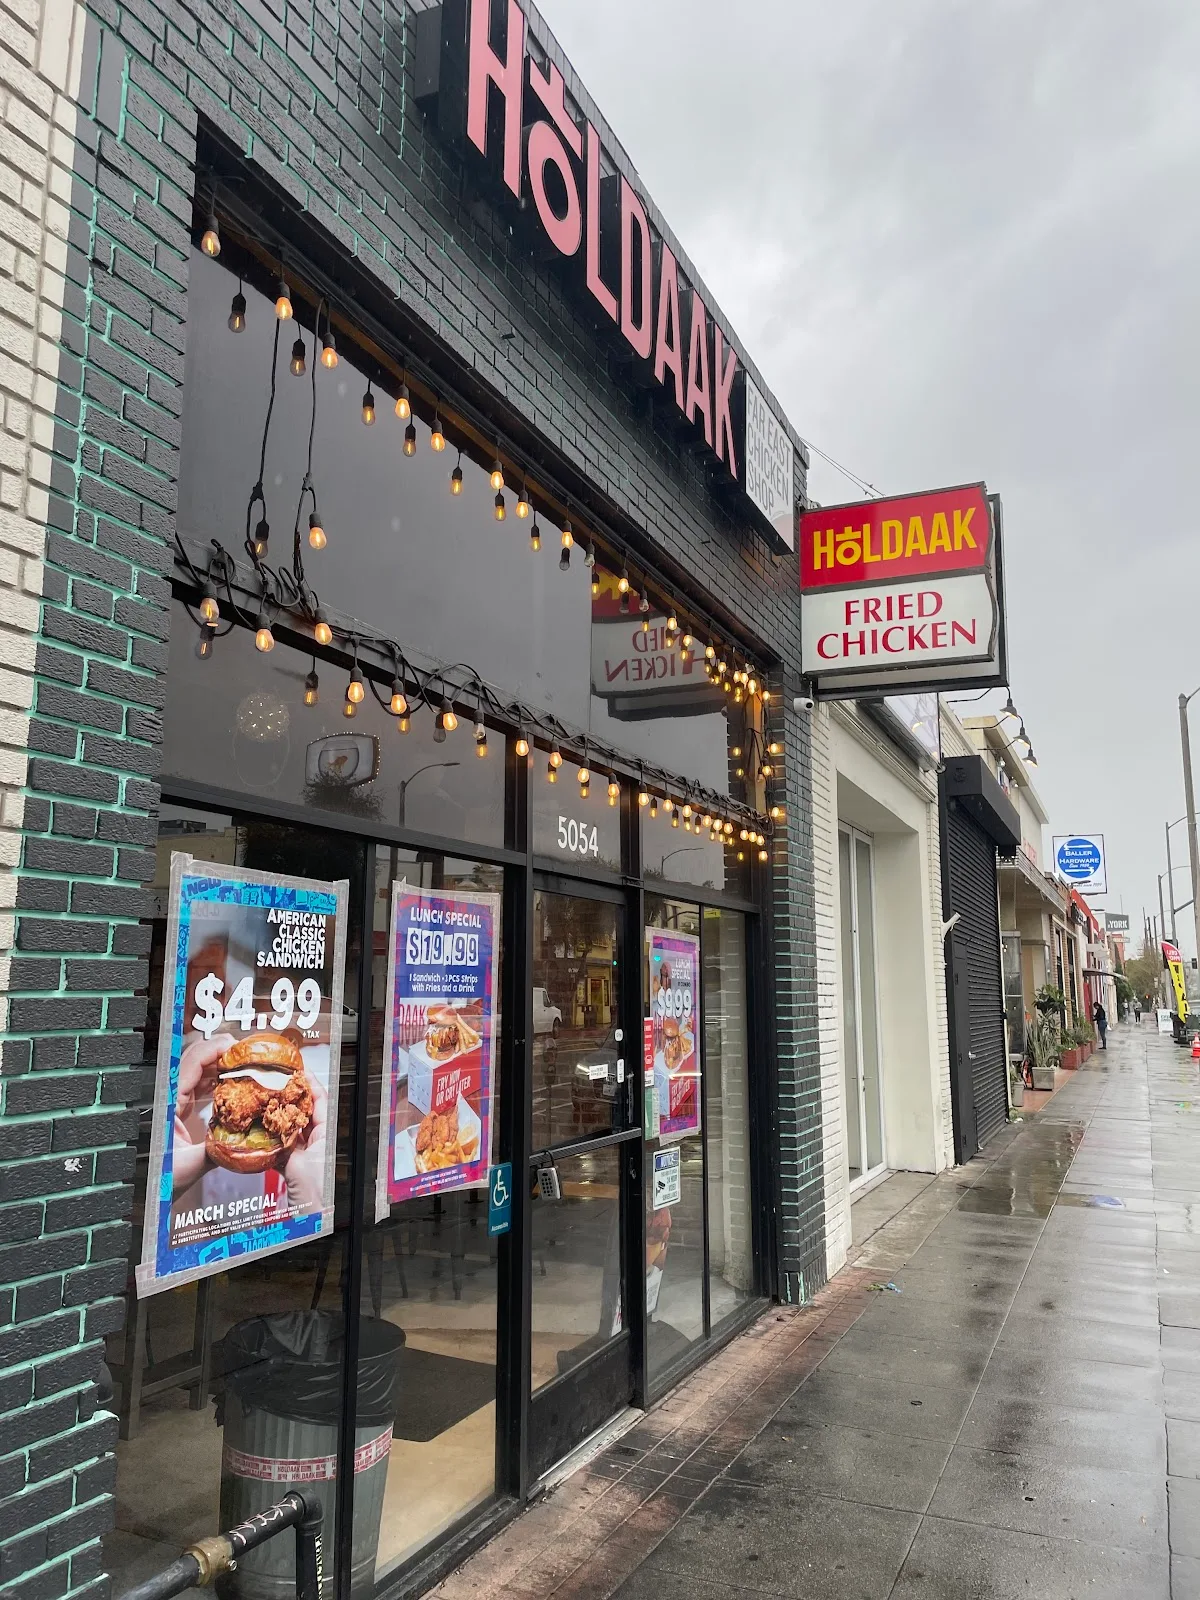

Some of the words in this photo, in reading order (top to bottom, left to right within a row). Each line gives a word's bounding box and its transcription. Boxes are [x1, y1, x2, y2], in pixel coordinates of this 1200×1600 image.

[748, 384, 765, 440] FAR
[768, 418, 790, 473] EAST
[748, 422, 789, 506] CHICKEN
[748, 459, 774, 516] SHOP
[845, 591, 943, 626] FRIED
[817, 618, 977, 659] CHICKEN
[557, 815, 599, 857] 5054
[267, 908, 327, 928] AMERICAN
[410, 907, 444, 925] LUNCH
[444, 911, 482, 929] SPECIAL
[1109, 920, 1128, 929] YORK
[279, 924, 326, 941] CLASSIC
[272, 938, 326, 955] CHICKEN
[408, 930, 478, 963] $19.99
[256, 951, 325, 970] SANDWICH
[413, 973, 441, 983] Sandwich
[448, 975, 460, 983] PCS
[461, 974, 478, 984] Strips
[671, 968, 691, 980] SPECIAL
[411, 983, 425, 992] with
[425, 984, 441, 992] Fries
[441, 984, 452, 992] and
[458, 984, 475, 993] Drink
[191, 972, 322, 1040] $4.99
[436, 1091, 445, 1107] OR
[445, 1084, 456, 1102] CRY
[456, 1075, 471, 1095] LATER
[437, 1074, 450, 1093] FRY
[174, 1204, 224, 1230] MARCH
[227, 1192, 277, 1218] SPECIAL
[178, 1227, 208, 1237] PARTICIPATING
[208, 1222, 232, 1231] LOCATIONS
